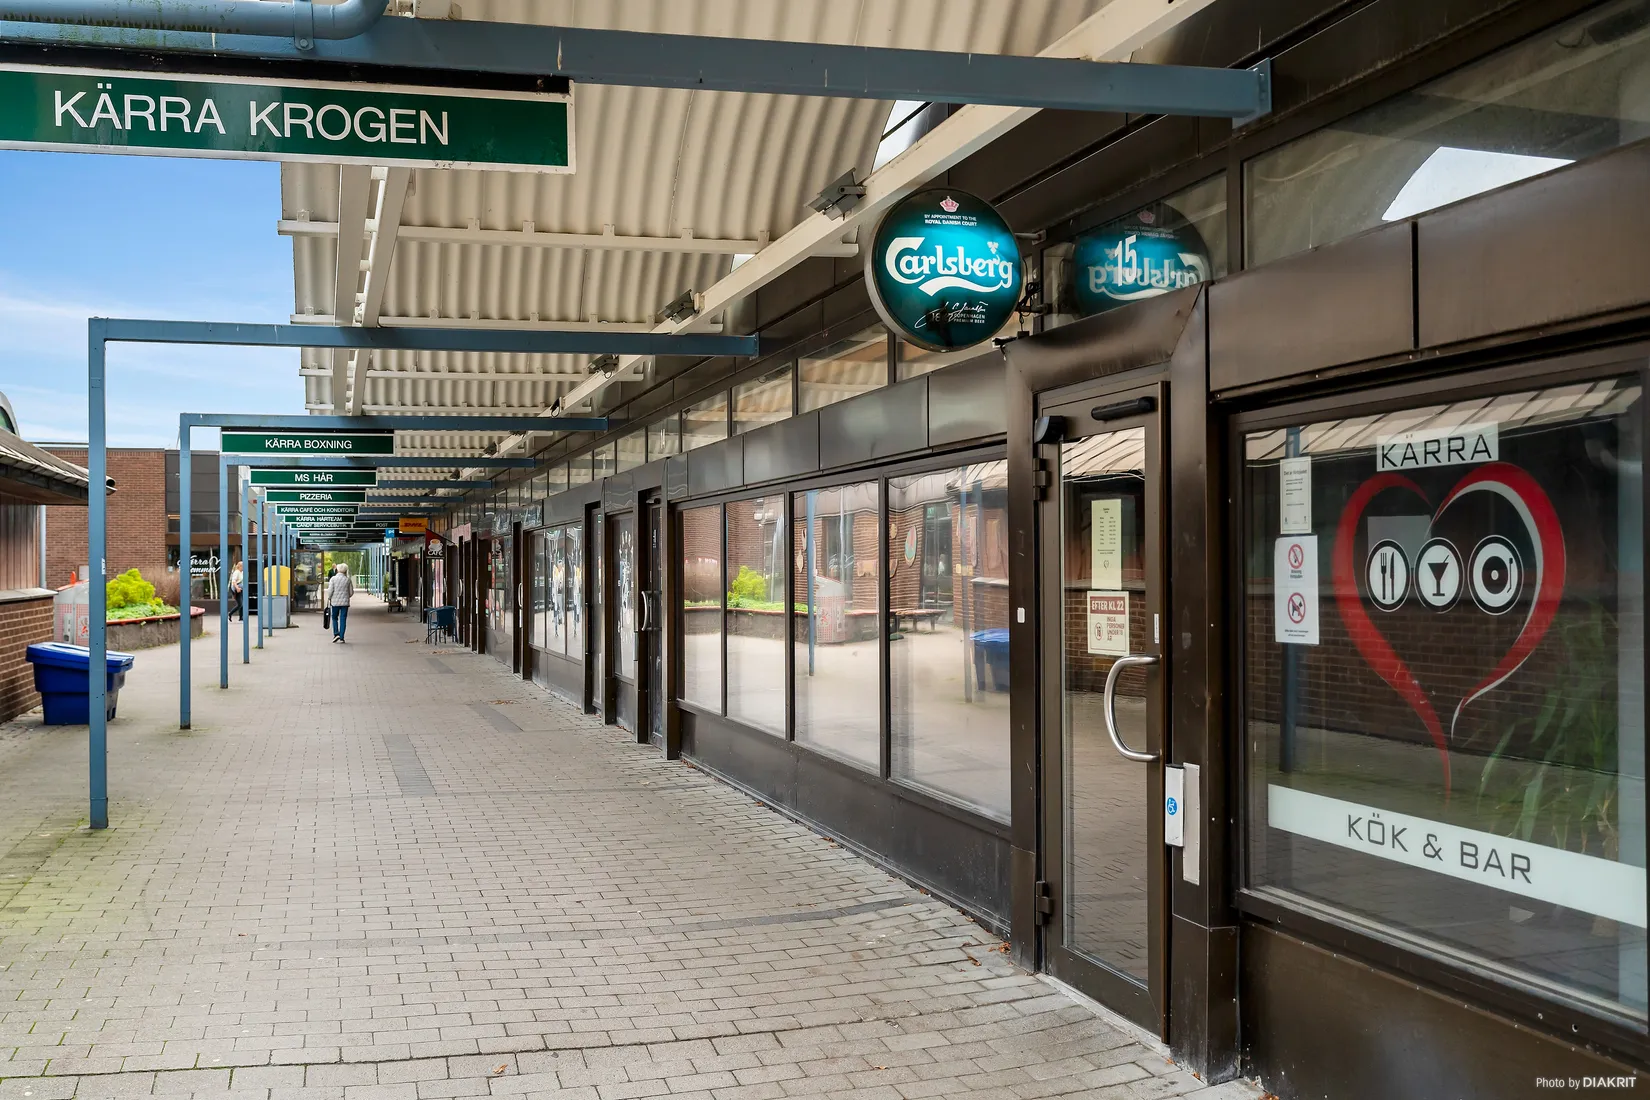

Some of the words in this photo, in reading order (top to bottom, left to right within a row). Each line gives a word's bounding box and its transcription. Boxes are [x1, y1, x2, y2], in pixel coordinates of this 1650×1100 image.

[54, 83, 226, 135] KÄRRA
[249, 101, 449, 146] KROGEN
[885, 237, 1013, 288] Carlsberg
[1115, 234, 1137, 287] 15
[265, 437, 302, 449] KÄRRA
[304, 439, 353, 449] BOXNING
[1381, 433, 1492, 469] KÄRRA
[294, 473, 310, 482] MS
[299, 493, 333, 501] PIZZERIA
[1091, 600, 1108, 611] EFTER
[1117, 600, 1124, 611] 22
[1348, 813, 1408, 852] KÖK
[1423, 833, 1444, 862] &
[1460, 841, 1532, 884] BAR
